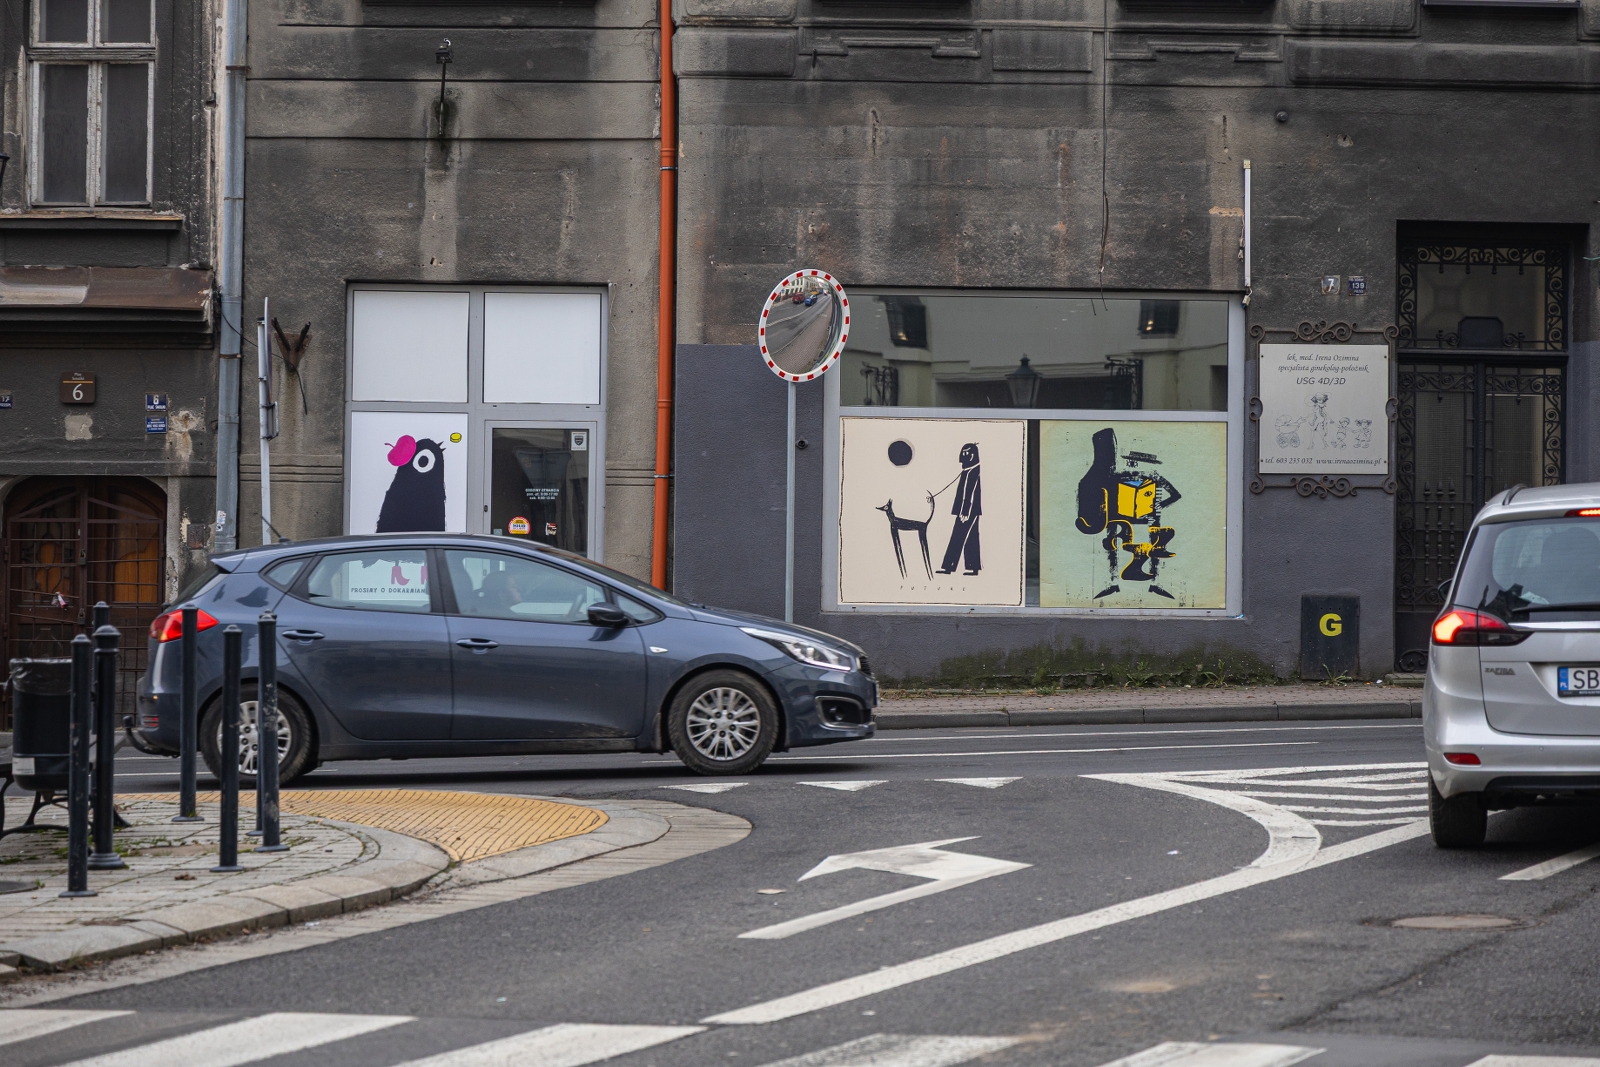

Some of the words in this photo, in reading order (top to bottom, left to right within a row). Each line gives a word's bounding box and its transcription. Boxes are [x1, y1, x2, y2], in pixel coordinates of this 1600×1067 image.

[1327, 278, 1335, 292] 7
[1299, 353, 1313, 361] med.
[1278, 364, 1309, 372] specjalista
[1296, 377, 1315, 385] USG
[1317, 377, 1347, 386] 4D/3D
[72, 383, 84, 401] 6
[153, 394, 160, 405] 6
[1316, 457, 1382, 466] www.irenaozimina.pl
[1319, 613, 1342, 637] G
[1484, 667, 1516, 675] ZAFIRA
